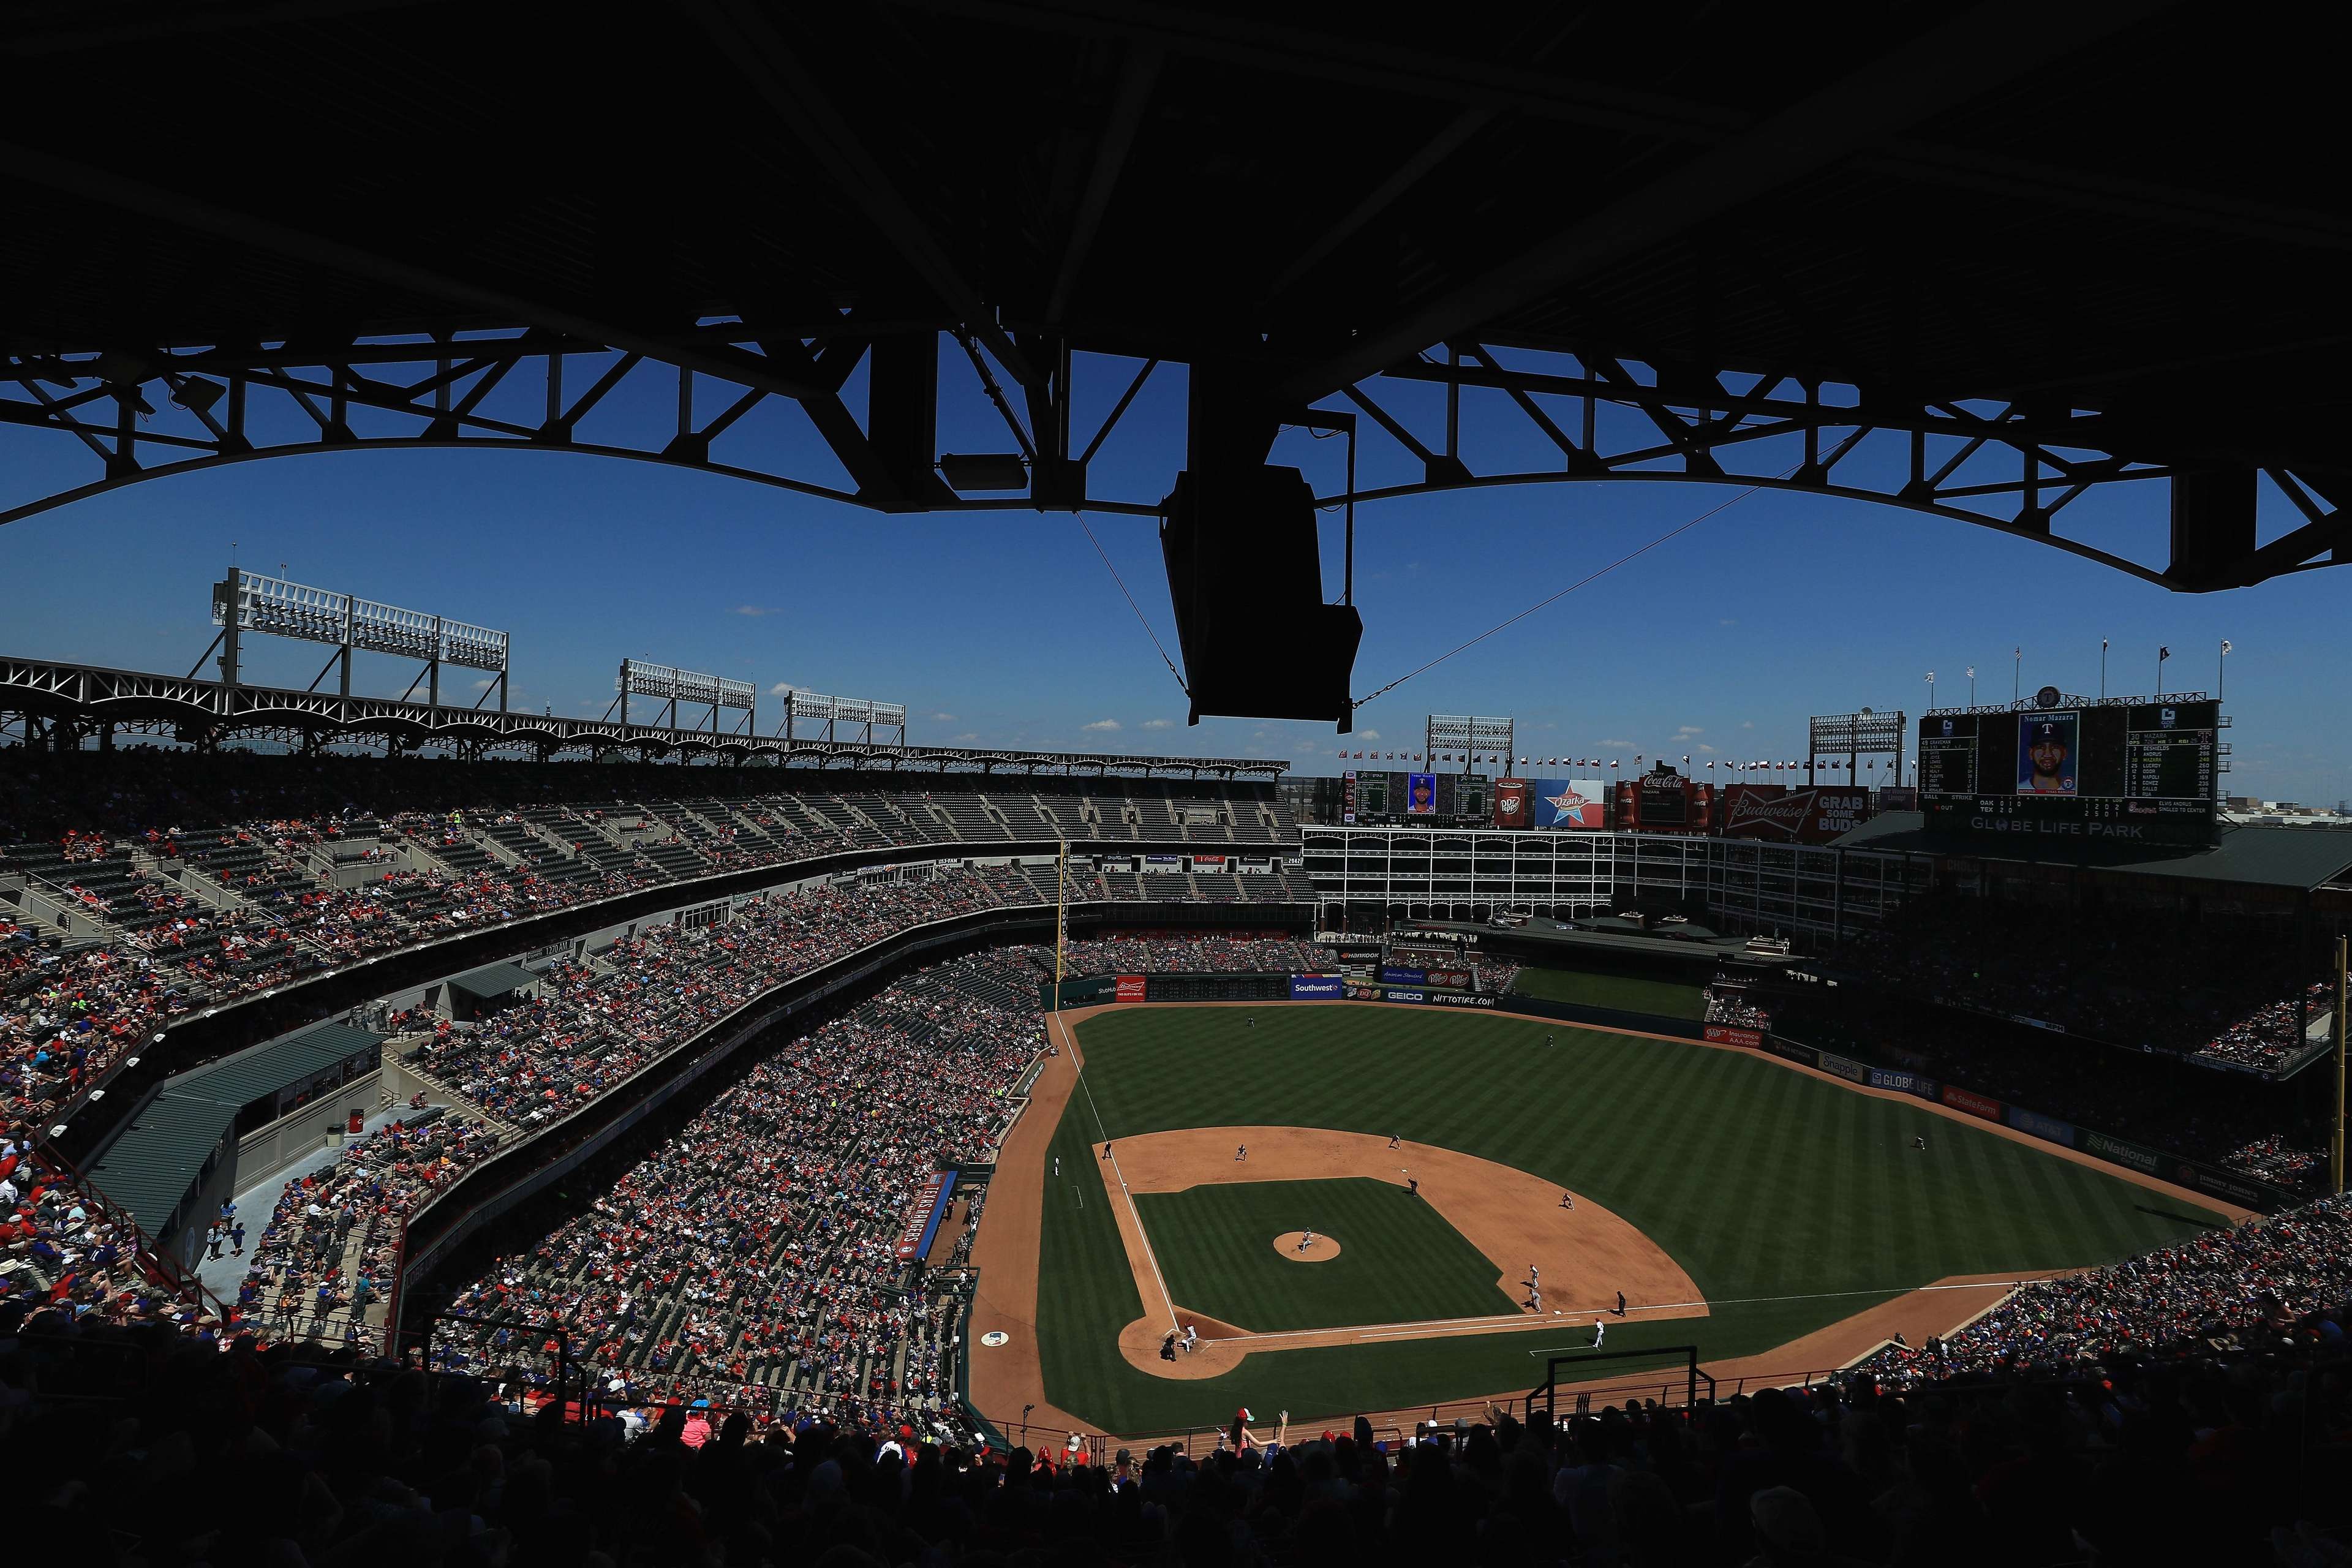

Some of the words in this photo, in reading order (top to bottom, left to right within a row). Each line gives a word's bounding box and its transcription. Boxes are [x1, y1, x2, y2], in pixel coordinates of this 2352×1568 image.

[1644, 775, 1684, 788] Coca-Cola
[1554, 796, 1585, 808] Ozarka
[1729, 799, 1813, 818] Budweiser
[1819, 796, 1864, 810] GRAB
[1826, 809, 1855, 819] SOME
[1818, 818, 1862, 832] BUDS
[1971, 816, 2034, 832] GLOBE
[2040, 819, 2082, 835] LIFE
[2089, 822, 2143, 839] PARK
[546, 944, 558, 955] 1270
[559, 941, 568, 952] AM
[1295, 984, 1333, 992] Southwest
[1388, 992, 1423, 1000] GEICO
[1433, 993, 1494, 1007] NITTOTIRE.COM
[1728, 1038, 1760, 1047] AAA.com
[1729, 1030, 1760, 1041] Insurance
[1823, 1055, 1858, 1076] Snapple
[1883, 1074, 1914, 1090] GLOBE
[1917, 1079, 1933, 1096] LIFE
[2035, 1121, 2064, 1137] AT&T
[2101, 1139, 2157, 1167] National
[919, 1186, 940, 1208] TEXAS
[903, 1210, 930, 1242] RANGERS
